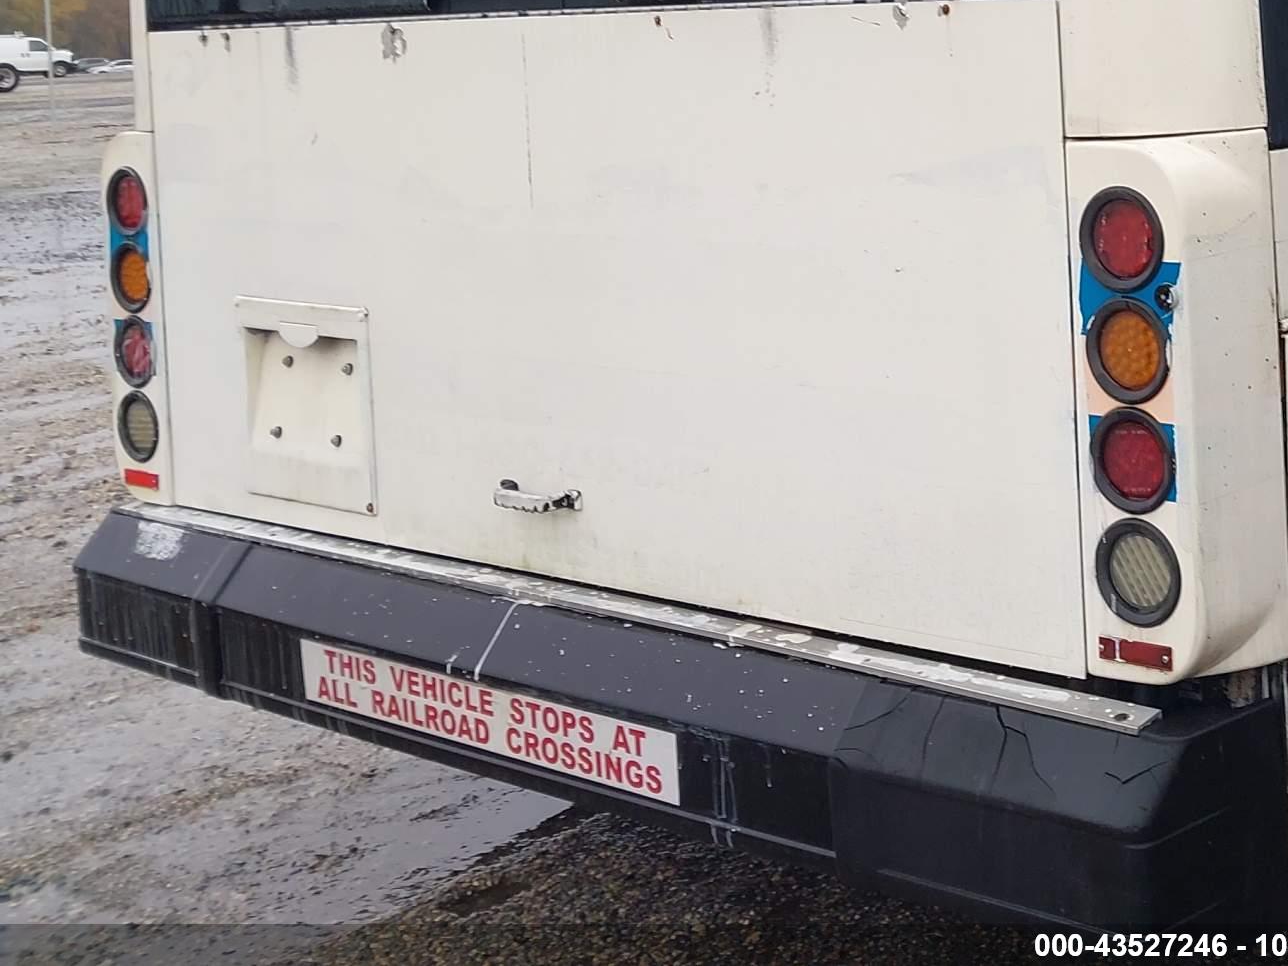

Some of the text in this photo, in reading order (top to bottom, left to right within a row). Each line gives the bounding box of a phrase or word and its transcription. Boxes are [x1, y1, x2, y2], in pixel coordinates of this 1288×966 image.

[317, 676, 664, 794] ALL RAILROAD CROSSINGS
[324, 650, 646, 757] THIS VEHICLE STOPS AT
